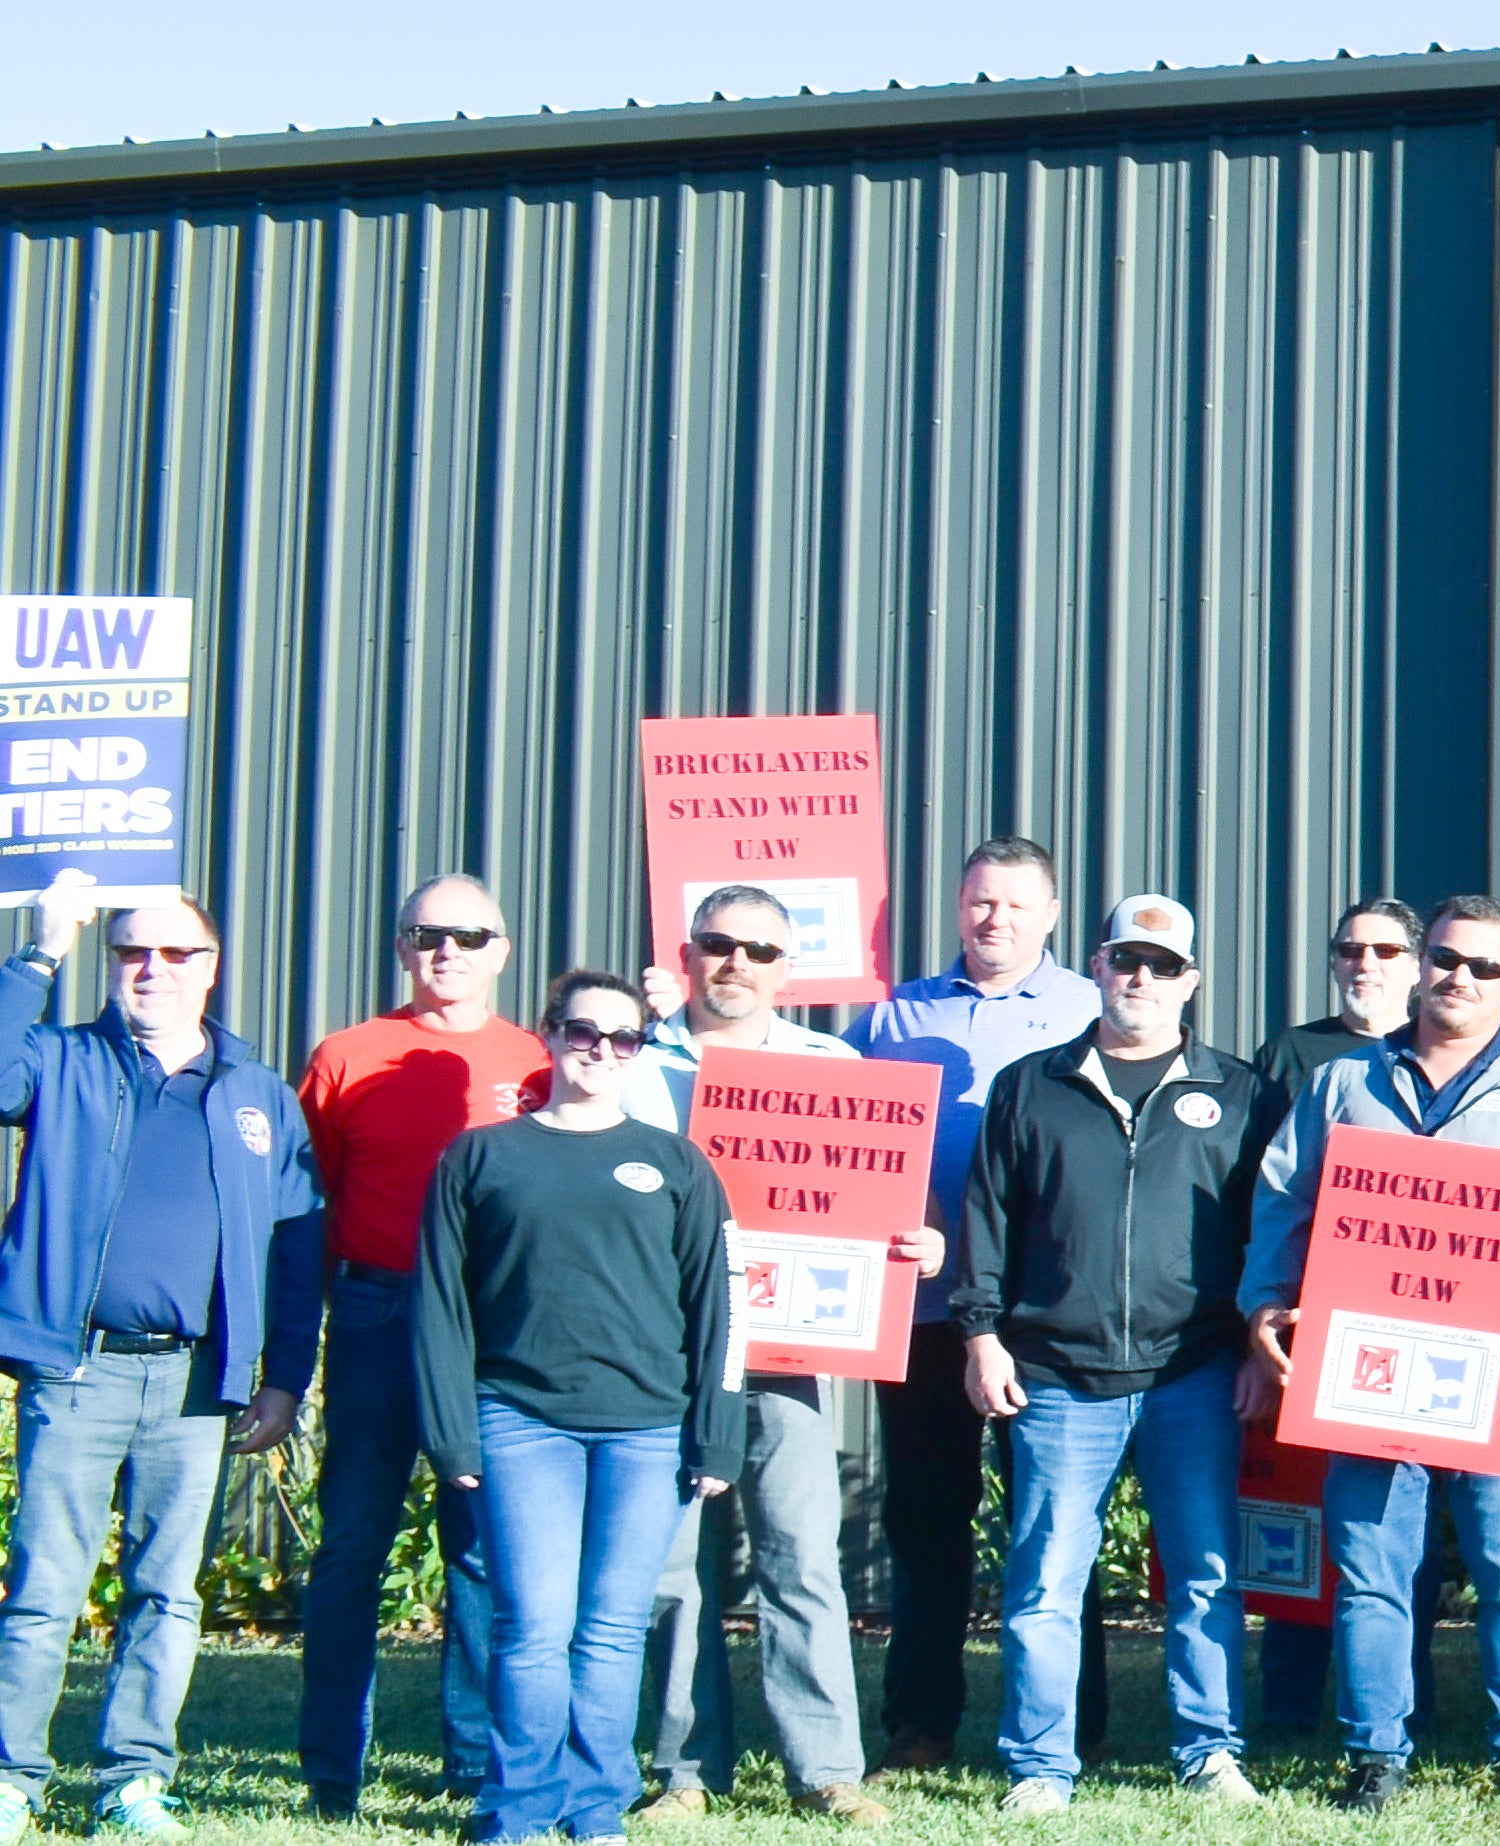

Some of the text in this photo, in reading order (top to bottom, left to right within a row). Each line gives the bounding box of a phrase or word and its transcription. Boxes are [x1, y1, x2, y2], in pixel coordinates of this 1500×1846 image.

[15, 607, 155, 669] UAW
[0, 690, 173, 717] STAND UP
[10, 736, 147, 786] END
[653, 750, 869, 776] BRICKLAYERS
[0, 787, 173, 838] TIERS
[668, 795, 860, 820] STAND WITH
[733, 837, 801, 860] UAW
[701, 1084, 927, 1126] BRICKLAYERS
[707, 1134, 907, 1174] STAND WITH
[766, 1186, 838, 1215] UAW
[1332, 1215, 1437, 1253] STAND
[1390, 1271, 1462, 1304] UAW
